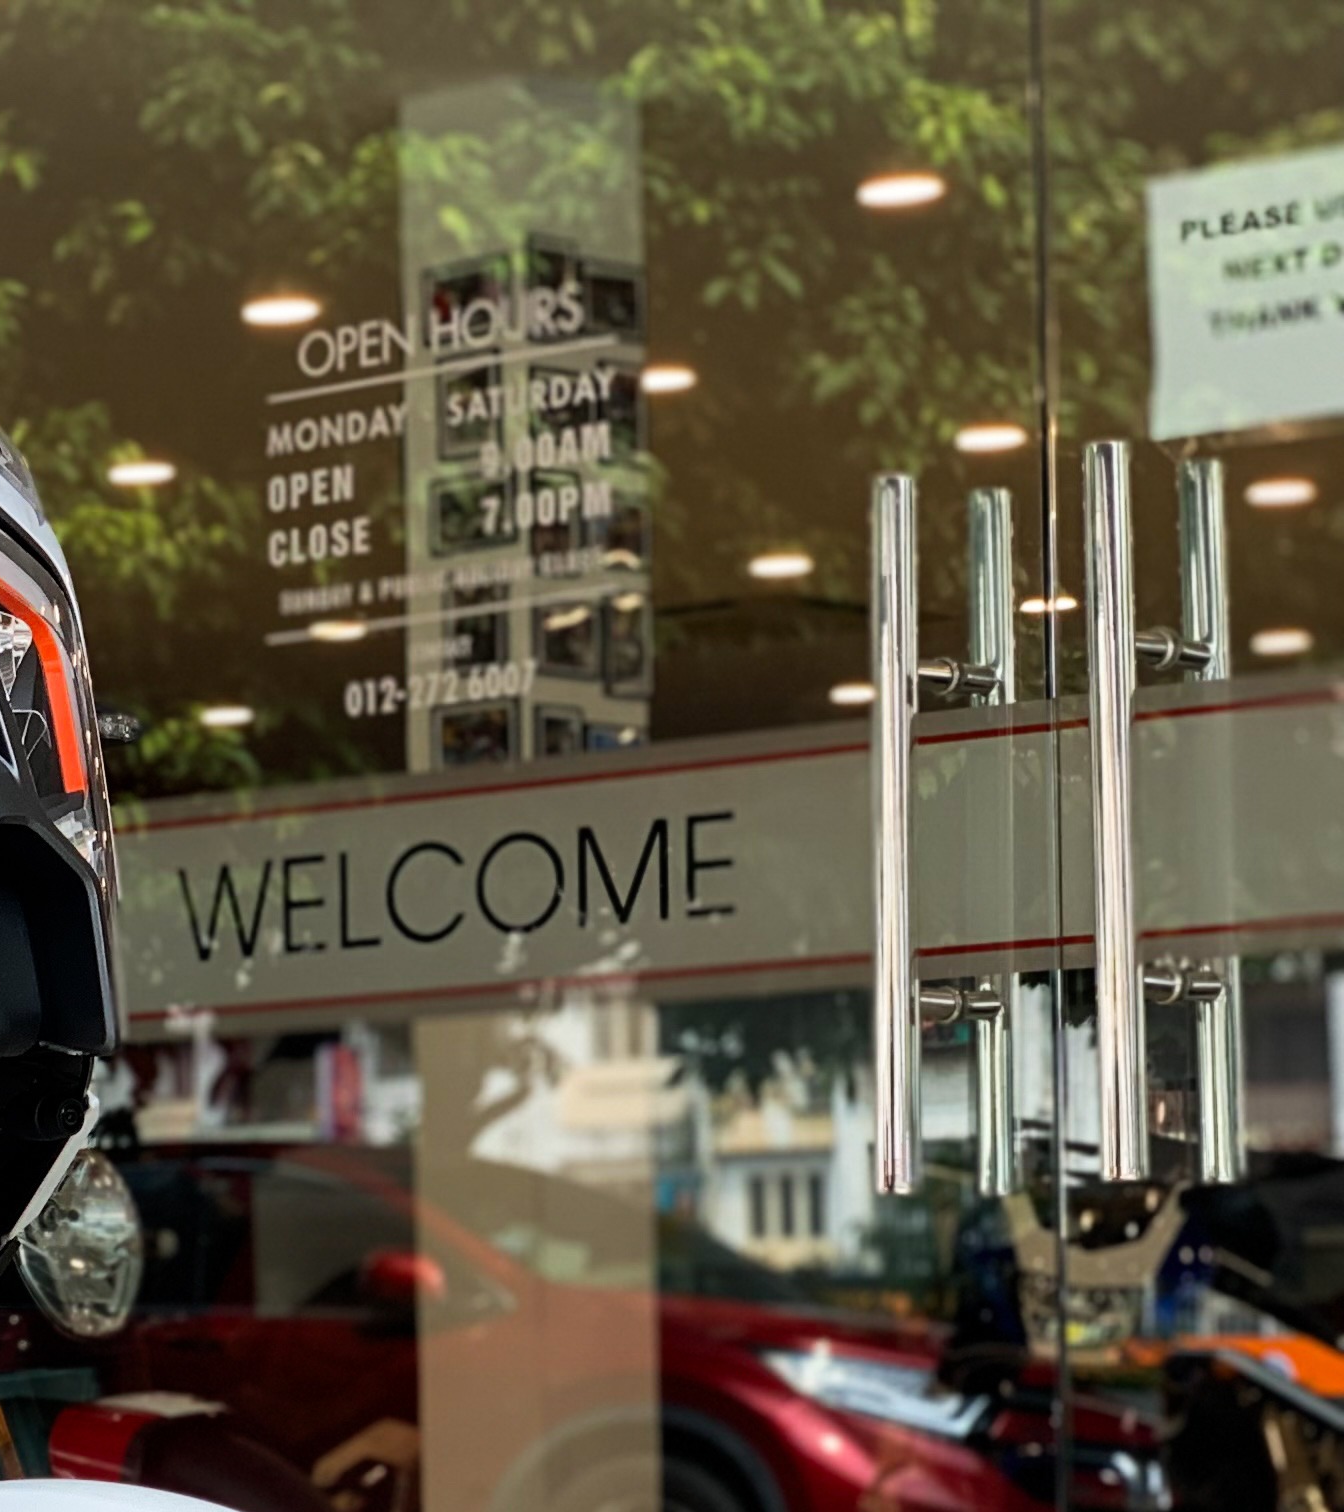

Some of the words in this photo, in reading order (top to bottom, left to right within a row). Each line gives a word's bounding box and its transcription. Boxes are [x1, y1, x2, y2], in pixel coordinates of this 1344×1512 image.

[1180, 199, 1300, 244] PLEASE
[297, 317, 413, 377] OPEN
[428, 286, 586, 351] HOURS
[265, 403, 409, 458] MONDAY
[446, 366, 615, 426] SATURDAY
[267, 464, 355, 512] OPEN
[267, 517, 372, 568] CLOSE
[480, 481, 612, 536] 7.00PM
[343, 669, 460, 719] 012-272
[467, 658, 538, 700] 6007
[178, 811, 734, 961] WELCOME
